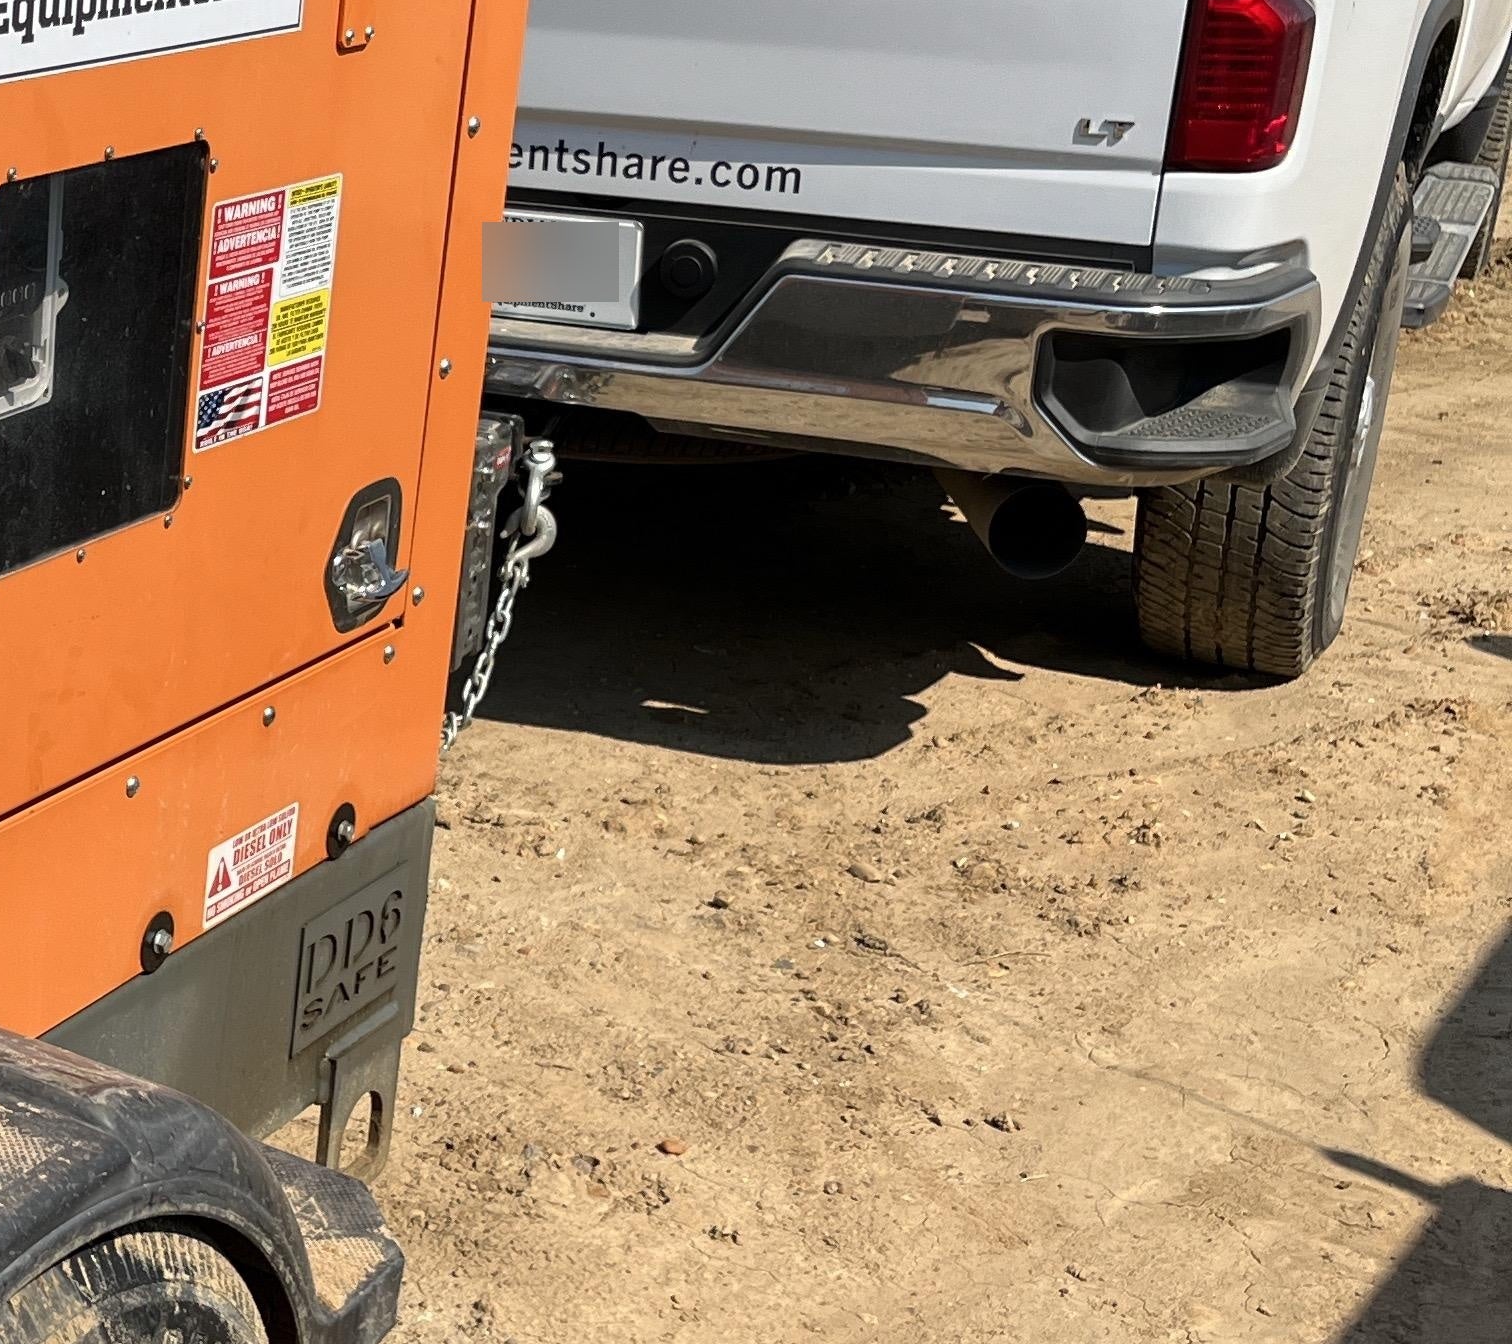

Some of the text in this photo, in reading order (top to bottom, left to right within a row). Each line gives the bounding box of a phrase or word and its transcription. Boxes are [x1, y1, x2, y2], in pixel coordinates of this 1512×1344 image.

[1072, 118, 1135, 147] LT
[509, 140, 801, 194] entshare.com
[224, 196, 276, 223] WARNING
[219, 274, 260, 295] WARNING
[232, 834, 266, 866] DIESEL
[269, 818, 293, 845] ONLY
[300, 946, 398, 1031] SAFE
